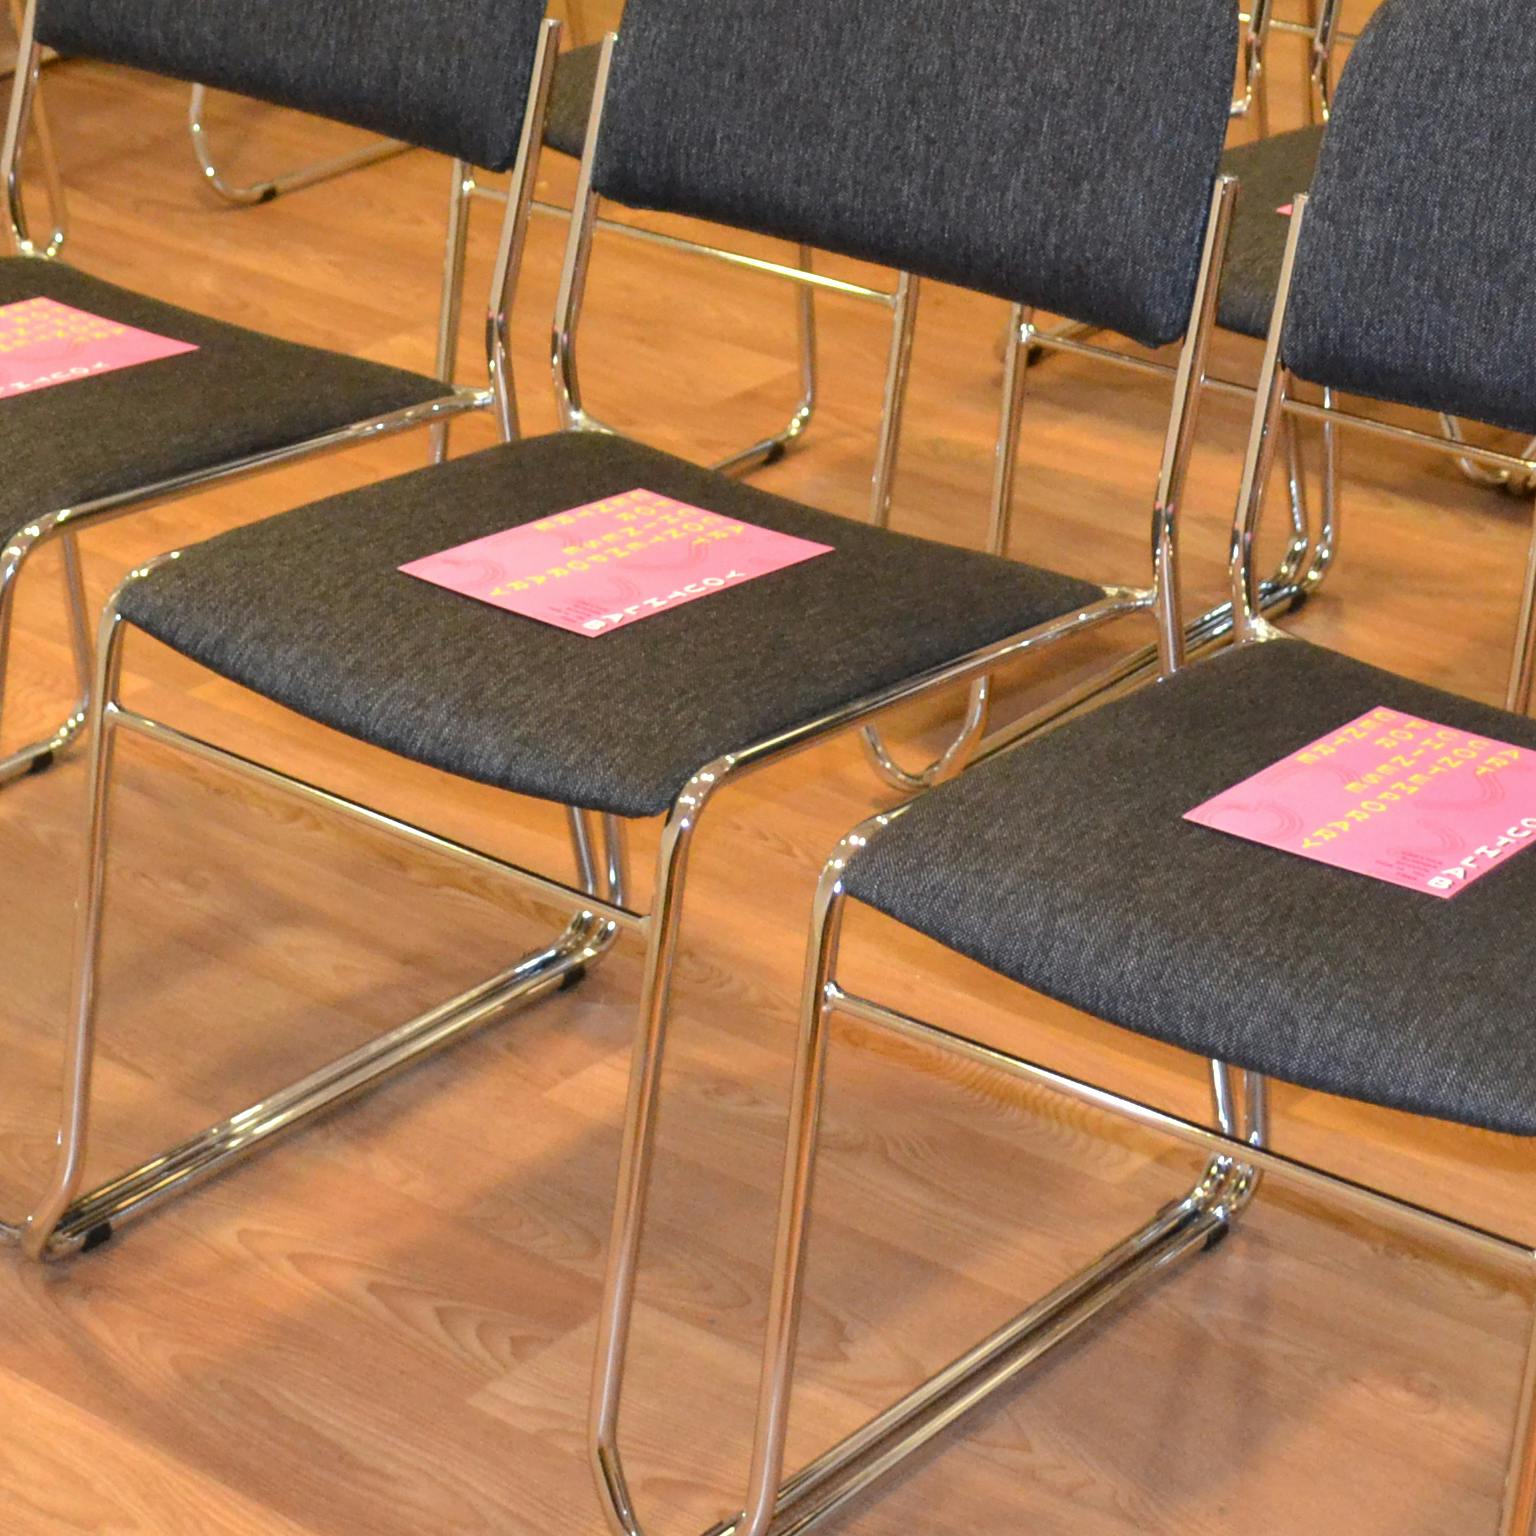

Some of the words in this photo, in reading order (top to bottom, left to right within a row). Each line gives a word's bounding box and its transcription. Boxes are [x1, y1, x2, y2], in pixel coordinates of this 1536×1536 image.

[1296, 710, 1397, 764] CENTRE
[1344, 729, 1460, 793] CHINESE
[1374, 720, 1430, 749] FOR
[1476, 749, 1521, 776] ART
[1302, 739, 1491, 849] CONTEMPORARY
